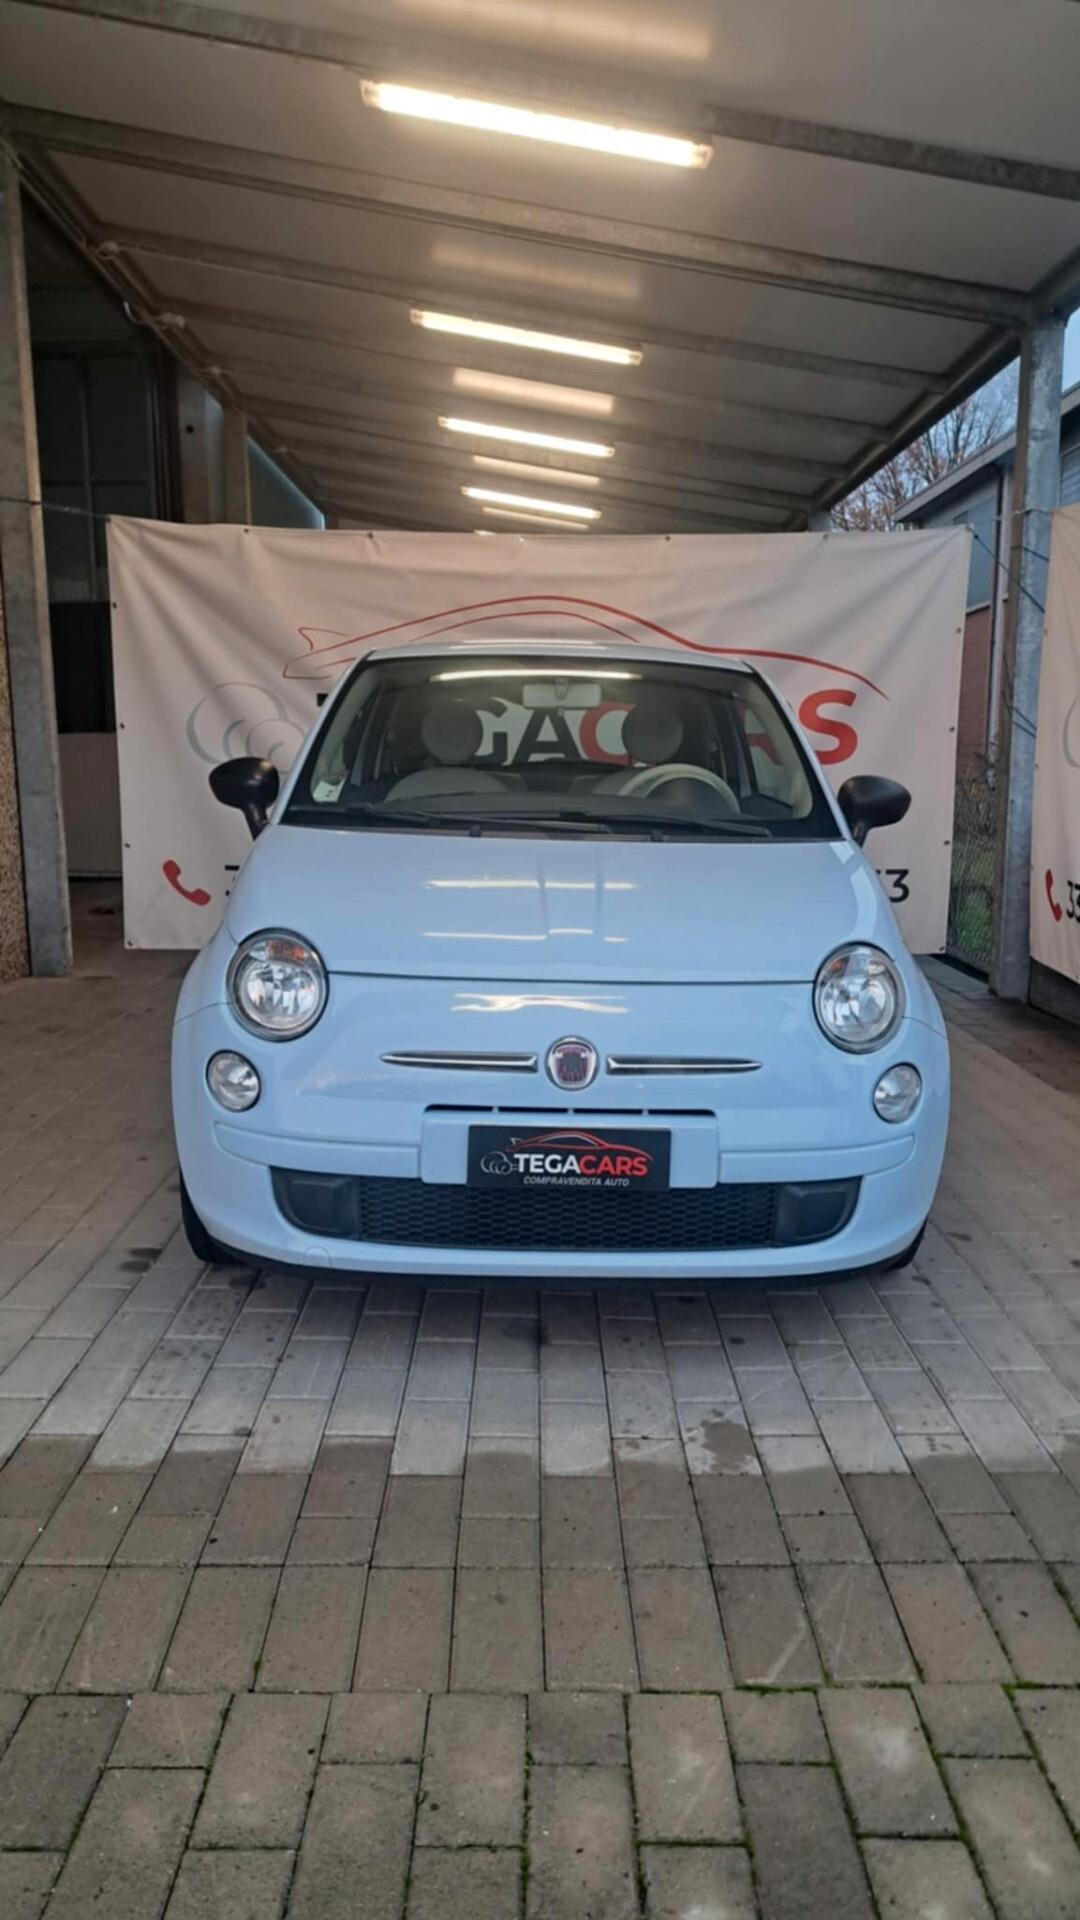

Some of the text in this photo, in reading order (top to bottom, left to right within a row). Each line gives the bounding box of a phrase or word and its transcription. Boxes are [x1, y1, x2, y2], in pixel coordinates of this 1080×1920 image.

[513, 1153, 648, 1176] TEGACARS
[523, 1175, 630, 1187] COMPRAVENDITA AUTO
